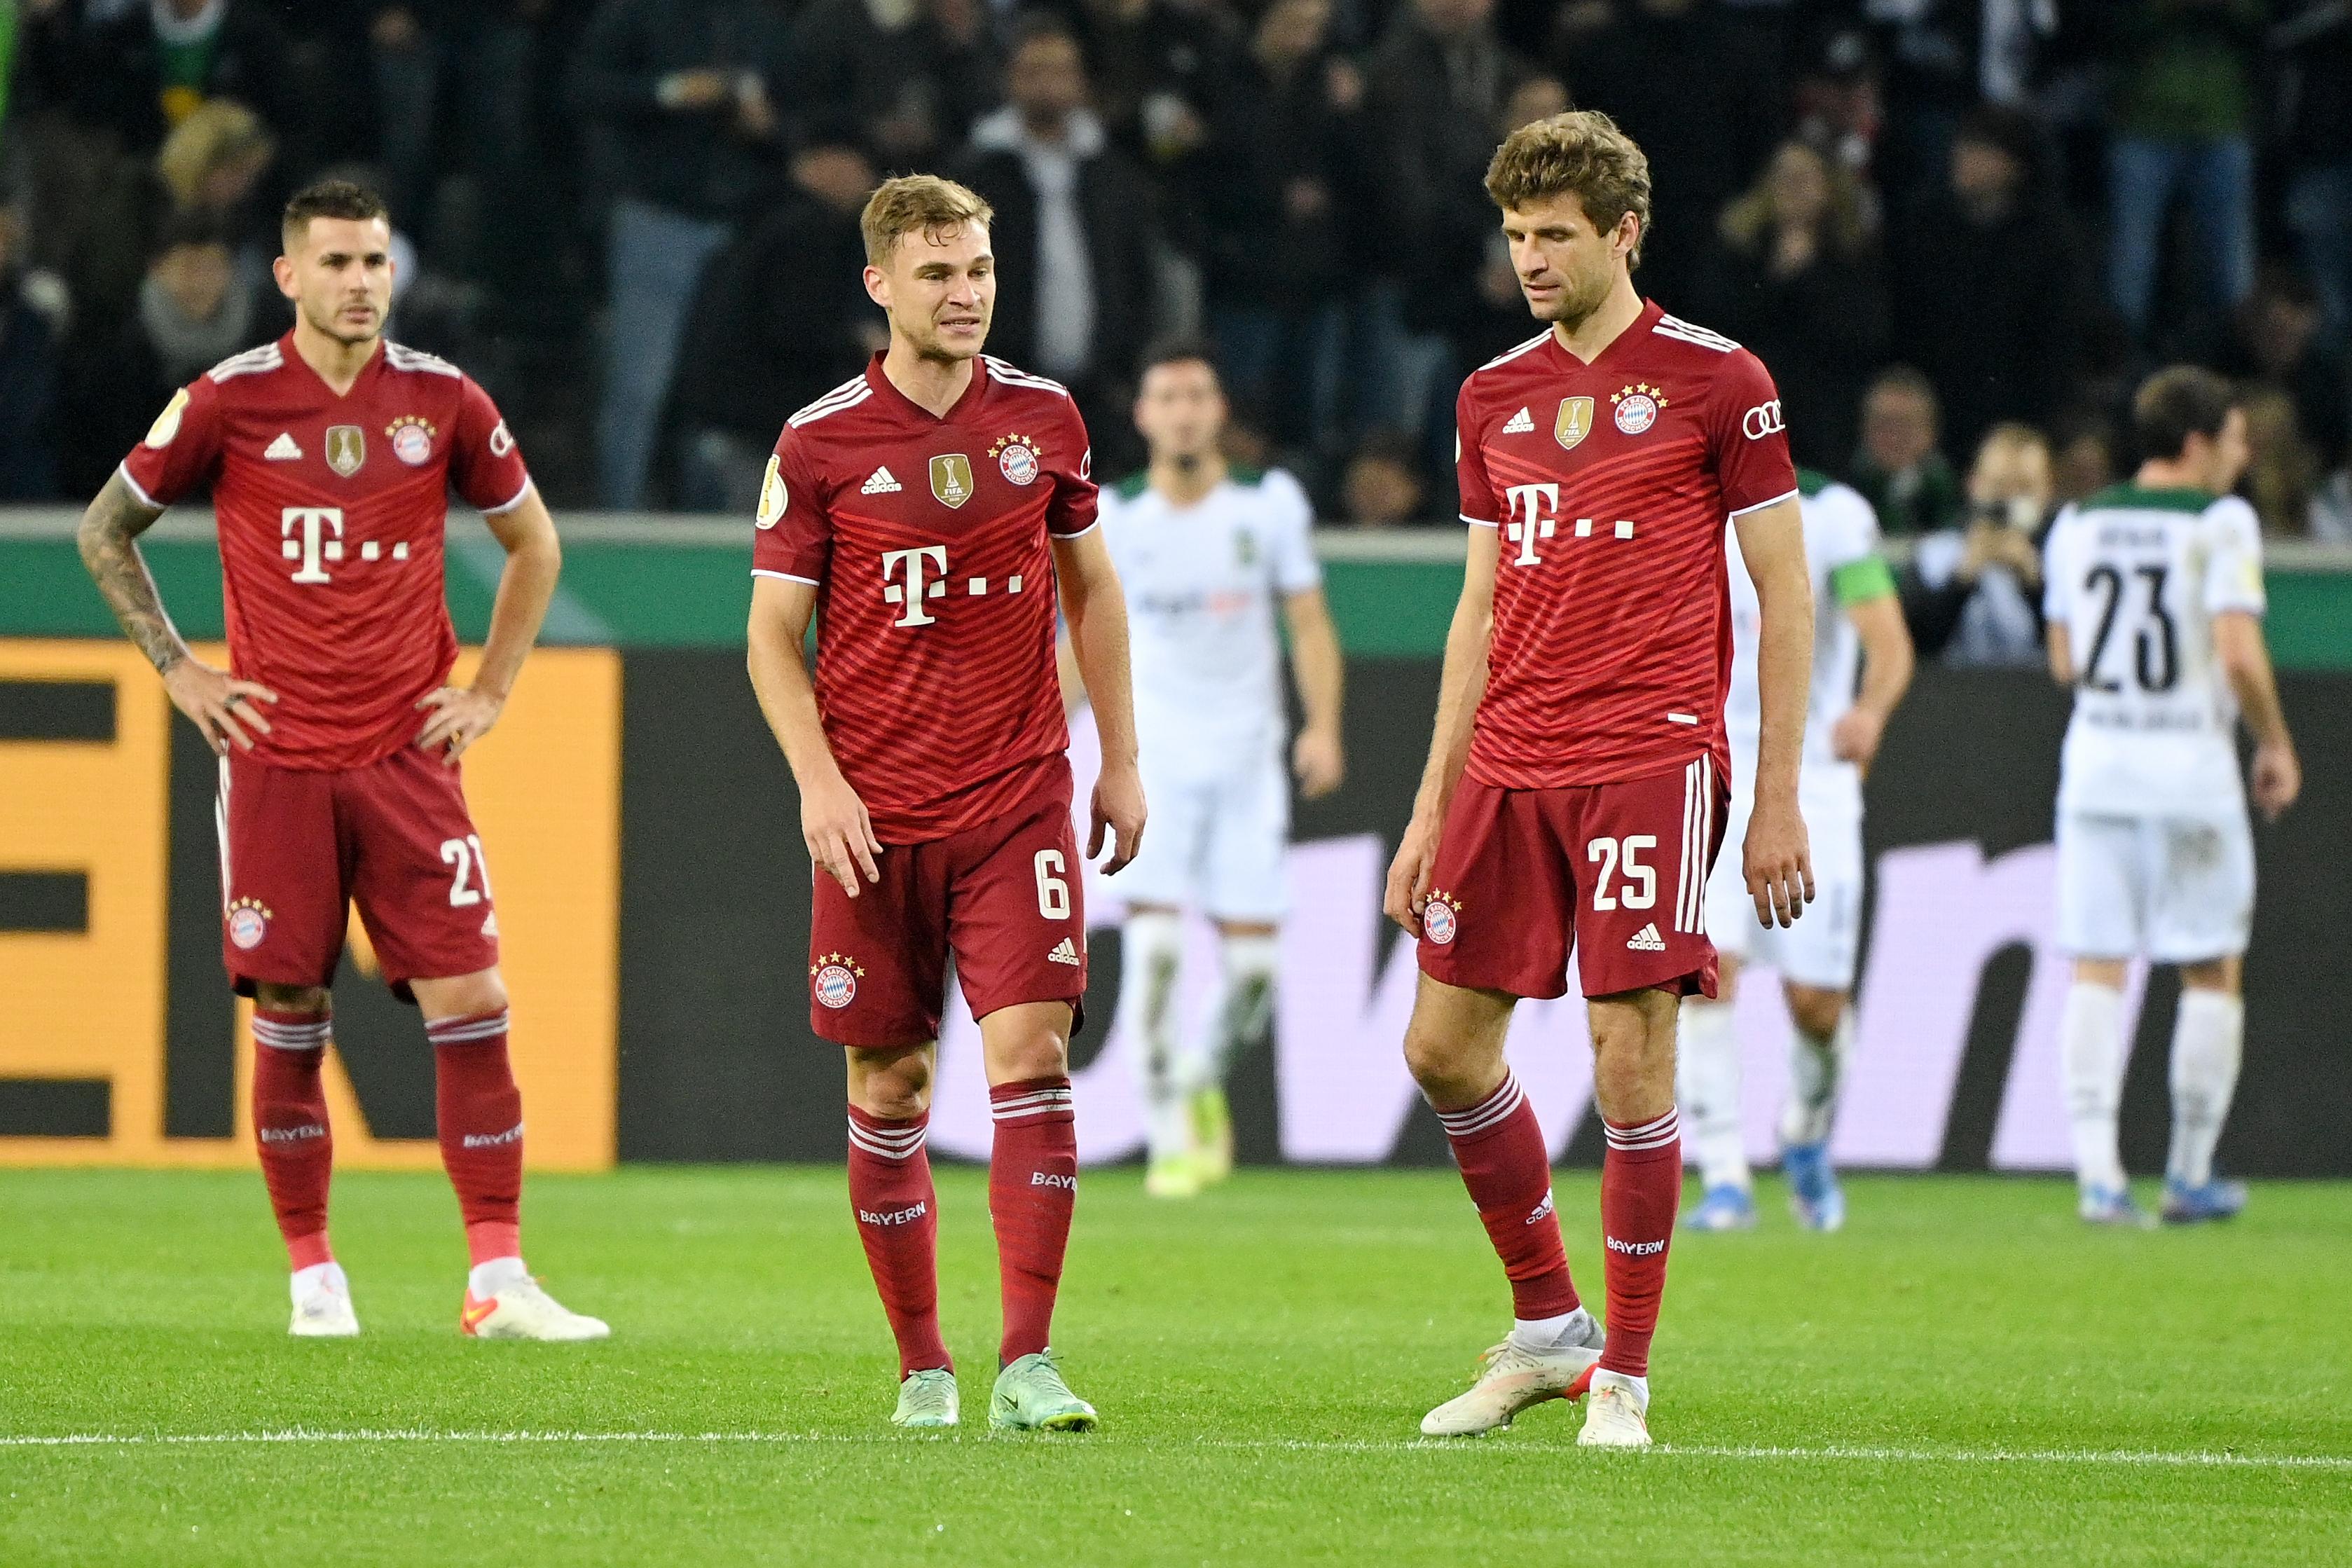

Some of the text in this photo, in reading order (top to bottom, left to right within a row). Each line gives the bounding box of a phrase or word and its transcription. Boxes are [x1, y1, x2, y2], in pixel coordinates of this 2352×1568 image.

[1502, 422, 1534, 434] adidas
[860, 482, 902, 495] adidas
[944, 487, 963, 495] FIFA
[2082, 562, 2179, 692] 23
[1587, 834, 1657, 911] 25
[1033, 849, 1071, 920] 6
[1626, 940, 1666, 951] adidas
[1047, 953, 1080, 966] adidas
[825, 968, 853, 984] BAYERN
[860, 1200, 926, 1226] BAYERN
[1607, 1235, 1665, 1256] BAYERN
